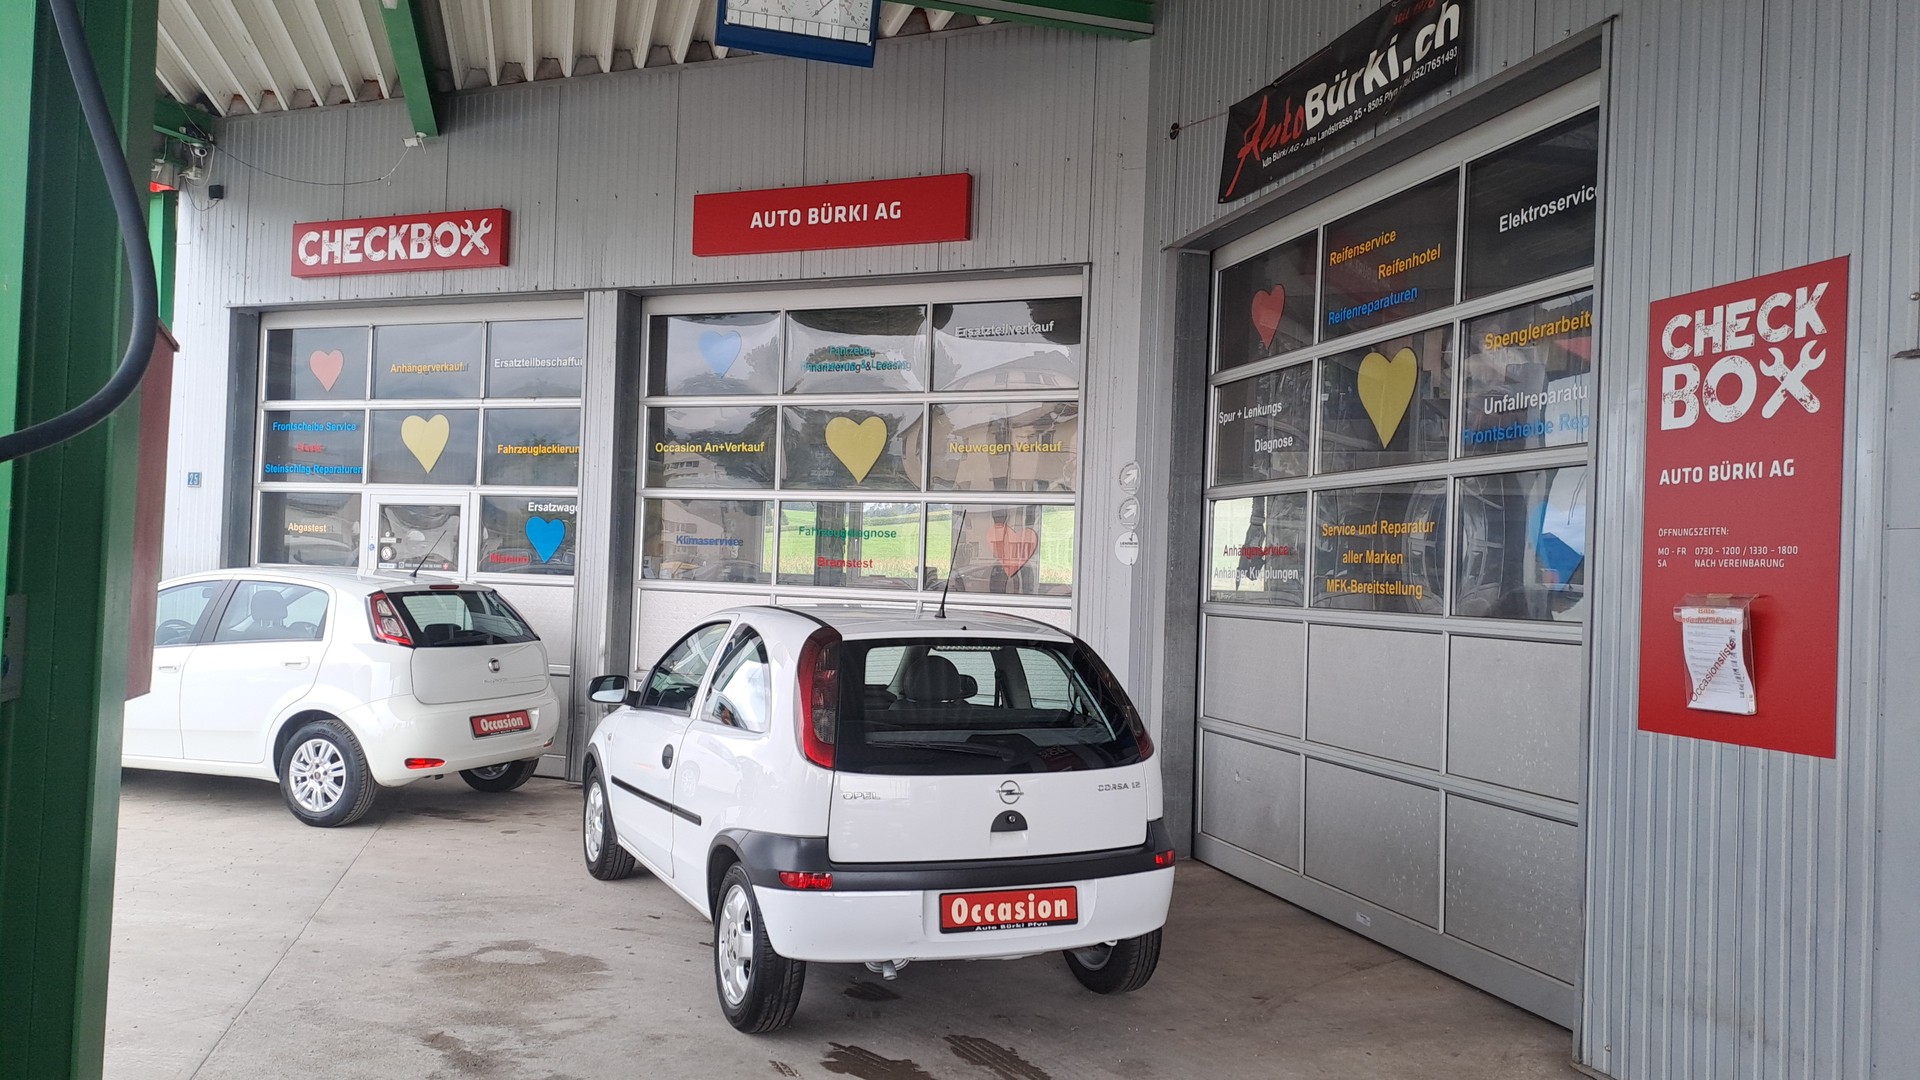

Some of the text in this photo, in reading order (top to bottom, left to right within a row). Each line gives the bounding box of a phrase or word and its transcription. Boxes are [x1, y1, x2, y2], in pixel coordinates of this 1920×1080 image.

[1317, 114, 1353, 141] Landstrasse
[1353, 107, 1362, 120] 25
[1367, 95, 1383, 113] 8505
[1411, 45, 1458, 82] 052/7651493
[750, 200, 901, 229] AUTO BÜRKI AG
[298, 217, 493, 266] CHECKBOX
[1329, 227, 1397, 266] Reifenservice
[1378, 243, 1441, 279] Reifenhotel
[1328, 285, 1418, 326] Reifenreparaturen
[955, 320, 1055, 338] Ersatzteilverkauf
[1661, 281, 1829, 361] CHECK
[390, 361, 464, 376] Anhängerverkauf
[1660, 340, 1827, 431] BOX
[1218, 409, 1236, 426] Spur
[1243, 400, 1283, 421] Lenkungs
[272, 421, 356, 432] Frontscheibe Service
[655, 441, 764, 453] Occasion An+Verkauf
[949, 440, 1062, 455] Neuwagen Verkauf
[1254, 433, 1294, 453] Diagnose
[265, 463, 363, 475] Steinschlag Reparaturen
[1659, 459, 1795, 485] AUTO BÜRKI AG
[189, 473, 199, 486] 25
[288, 522, 327, 534] Abgastest
[1322, 519, 1435, 537] Service und Reparatur
[1658, 526, 1729, 537] ÖFFNUNGSZEITEN:
[675, 534, 741, 547] Klimaservice
[1342, 550, 1403, 565] aller Marken
[1657, 547, 1670, 555] MO
[1676, 547, 1687, 555] FR
[1694, 546, 1713, 555] 0730
[1721, 546, 1741, 555] 1200
[1749, 546, 1768, 555] 1330
[1777, 545, 1798, 555] 1800
[816, 555, 874, 569] Bremstest
[1657, 558, 1785, 568] SA NACH VEREINBARUNG
[1326, 579, 1423, 599] MFK-Bereitstellung
[1690, 638, 1736, 702] Occasionsliste
[480, 714, 523, 731] Occasion
[842, 791, 881, 800] OPEL
[1097, 782, 1129, 792] CORSA
[951, 893, 1068, 925] Occasion
